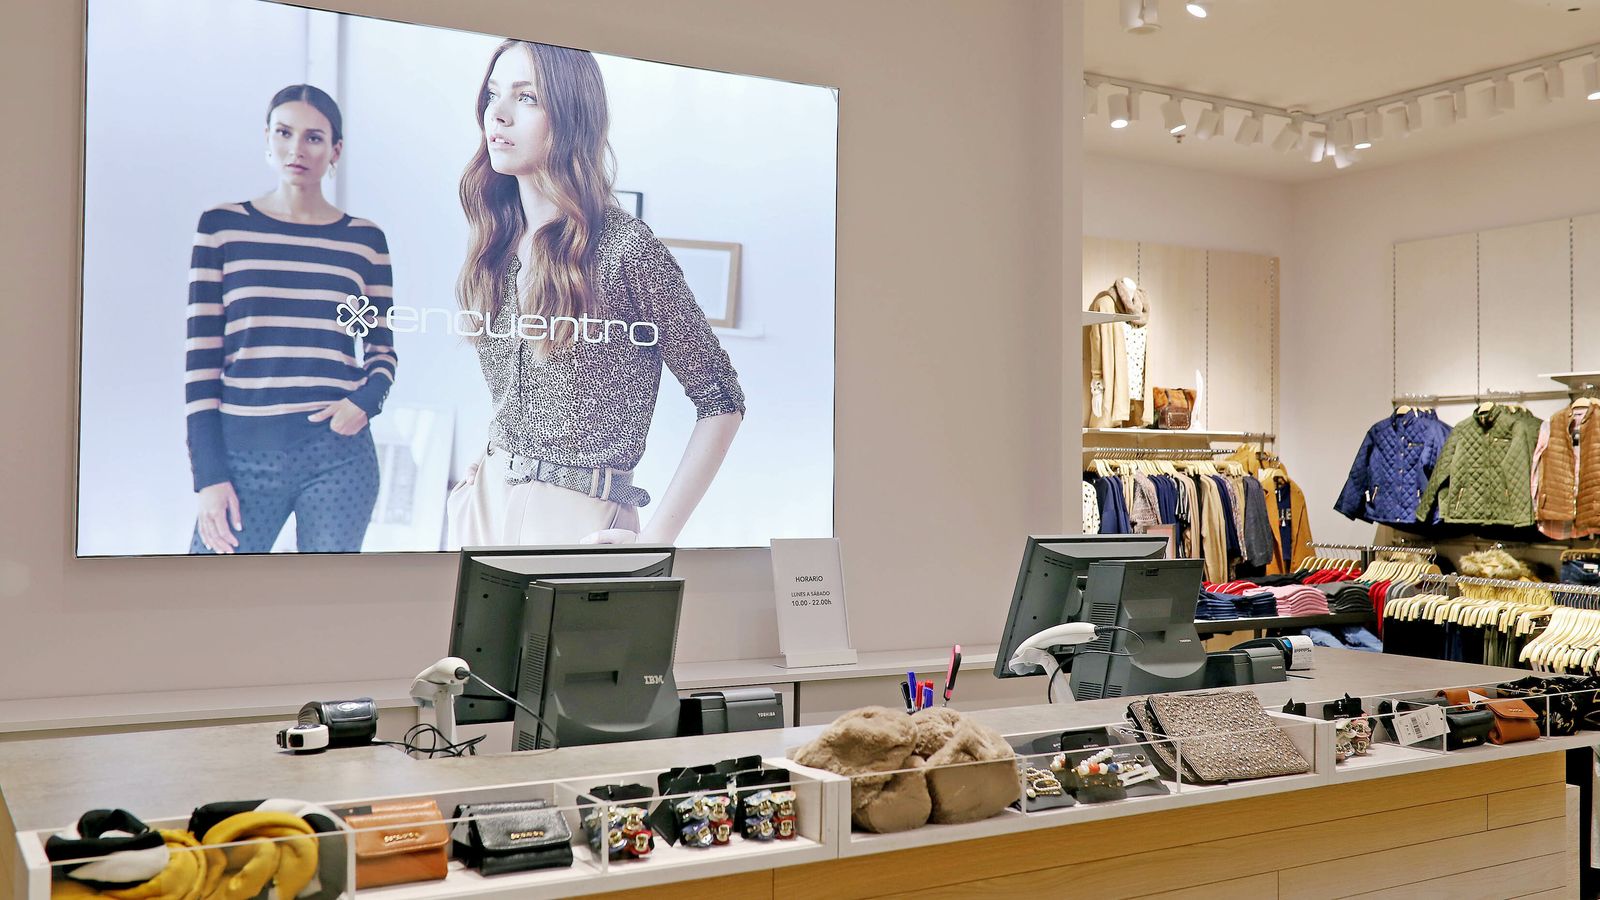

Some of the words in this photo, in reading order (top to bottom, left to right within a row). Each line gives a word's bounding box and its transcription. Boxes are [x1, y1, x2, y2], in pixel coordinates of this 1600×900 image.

[386, 305, 659, 347] encuentro
[795, 575, 824, 583] HORARIO
[643, 675, 665, 685] IBM
